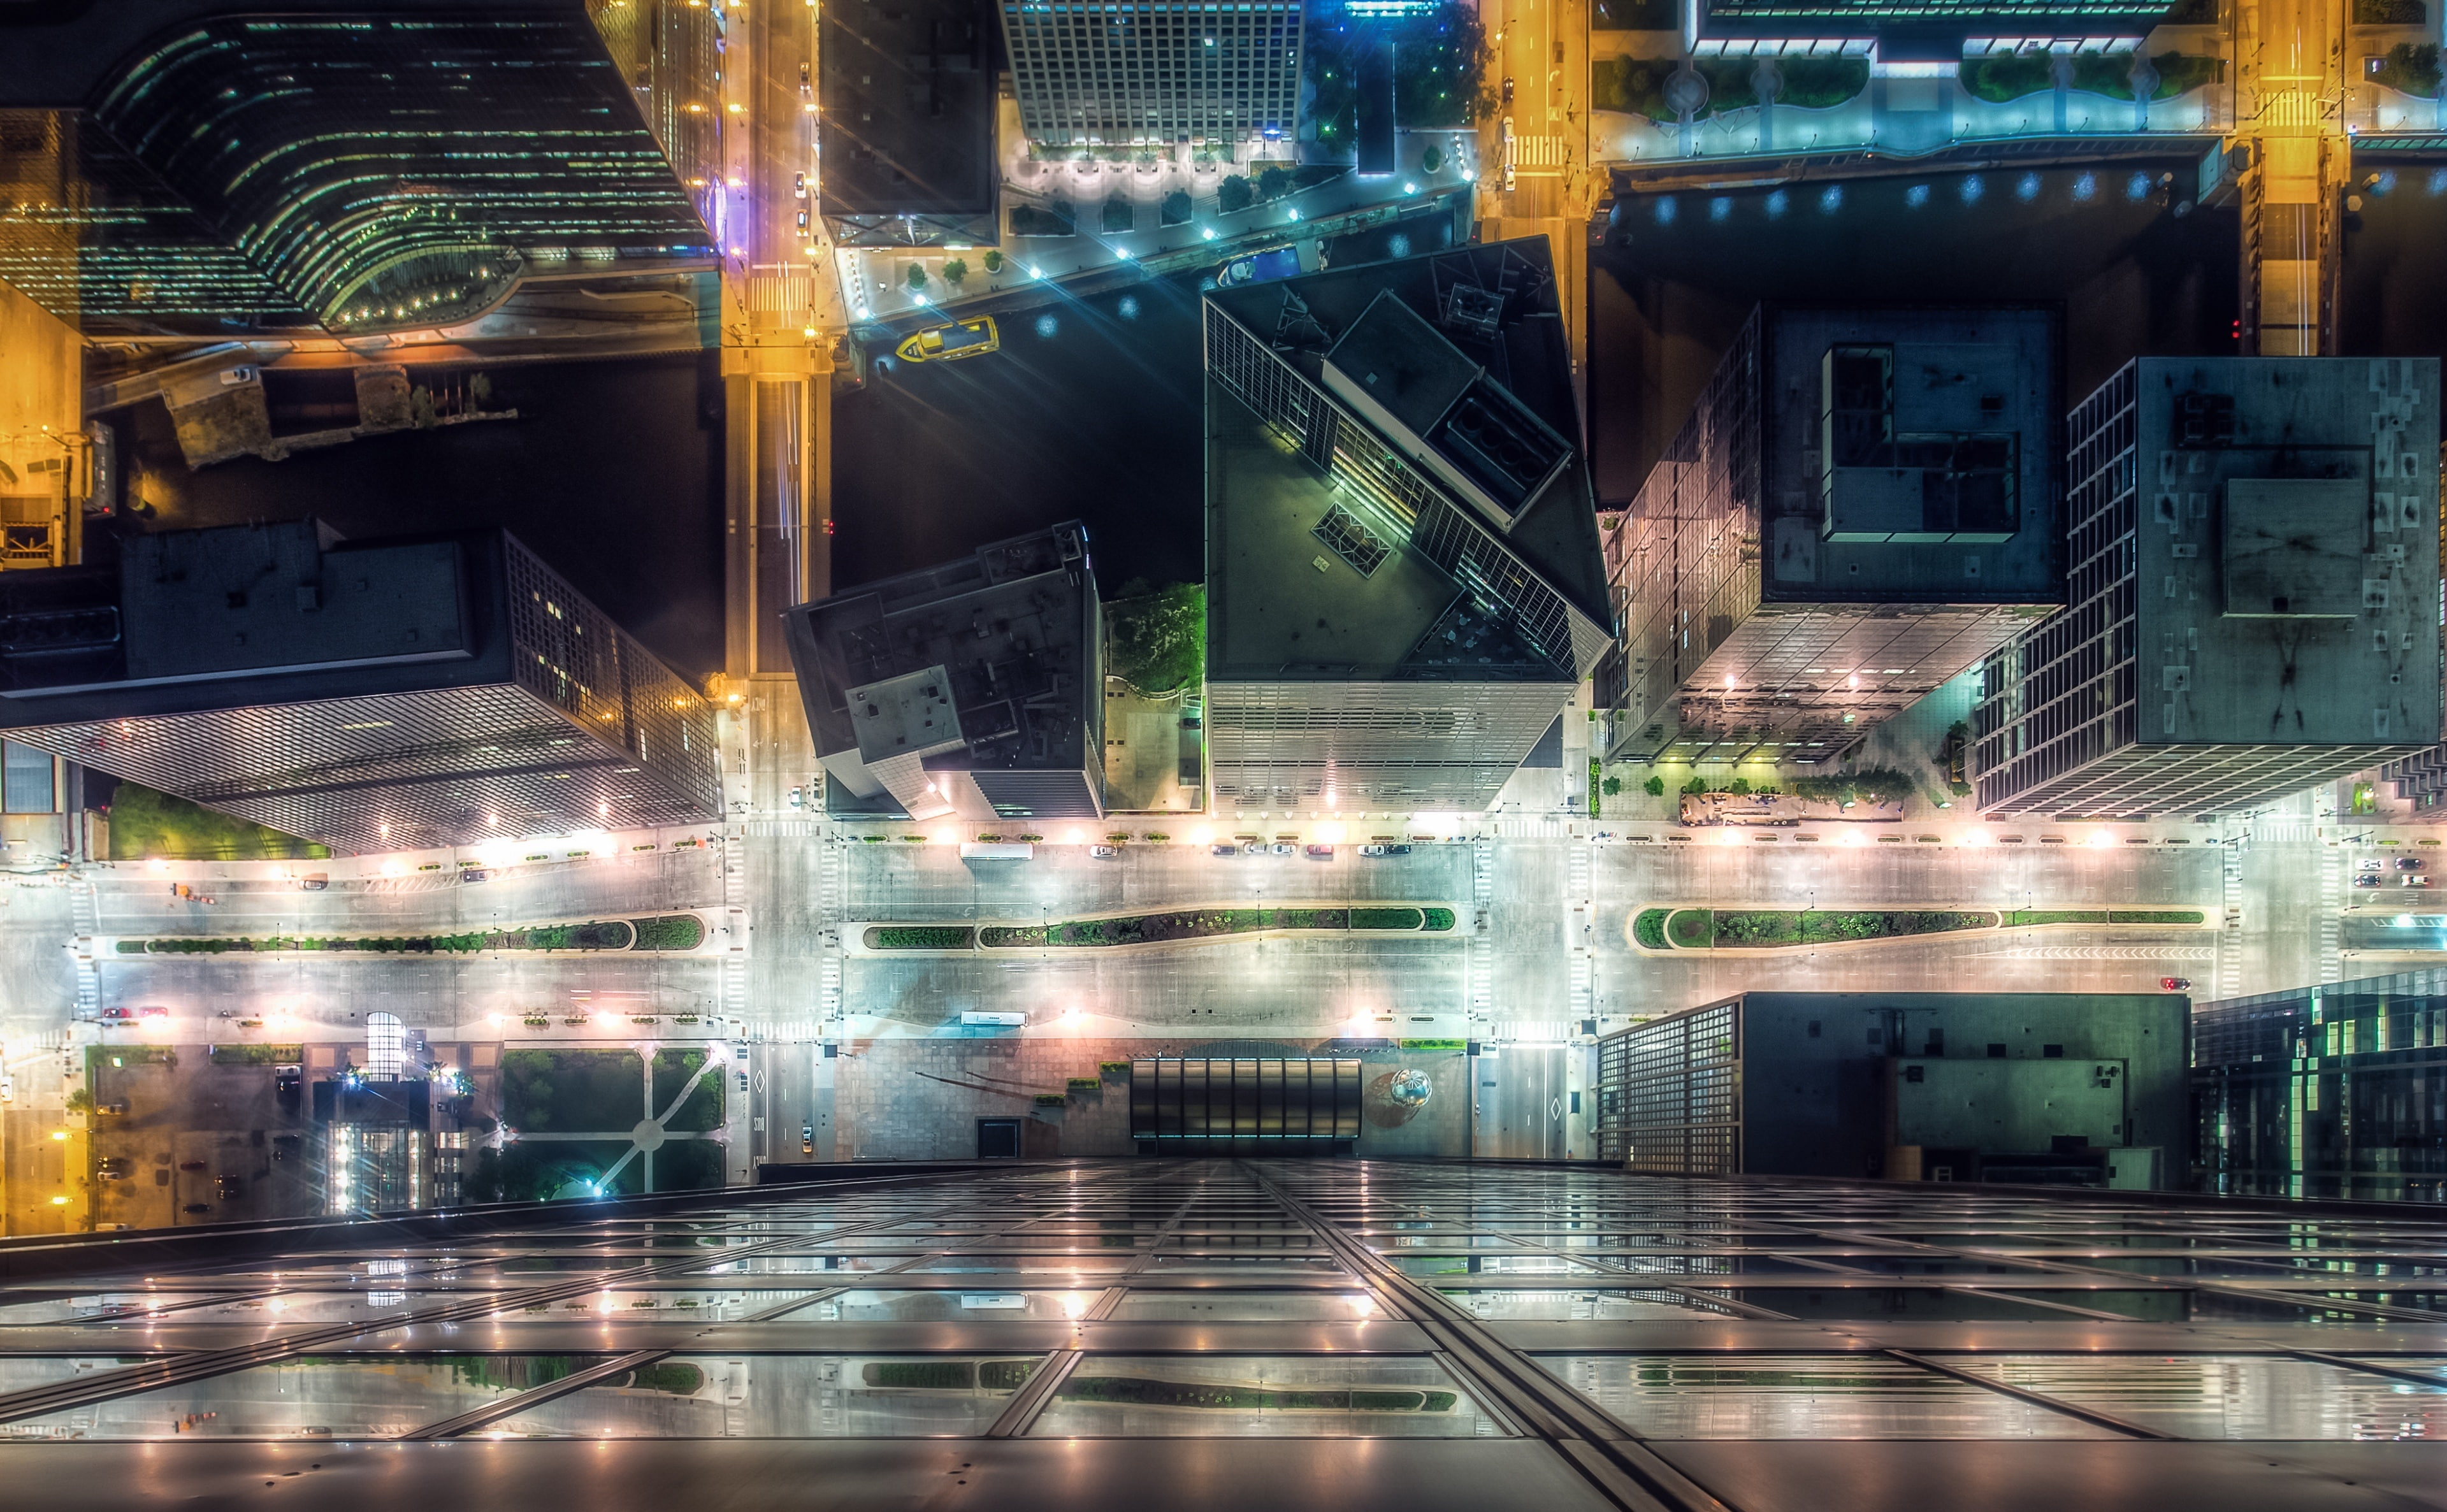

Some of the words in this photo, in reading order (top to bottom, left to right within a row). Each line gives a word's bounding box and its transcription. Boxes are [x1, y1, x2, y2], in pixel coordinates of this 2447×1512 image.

[1548, 106, 1563, 121] ONLY
[751, 697, 765, 712] ONLY
[754, 1117, 765, 1131] BUS
